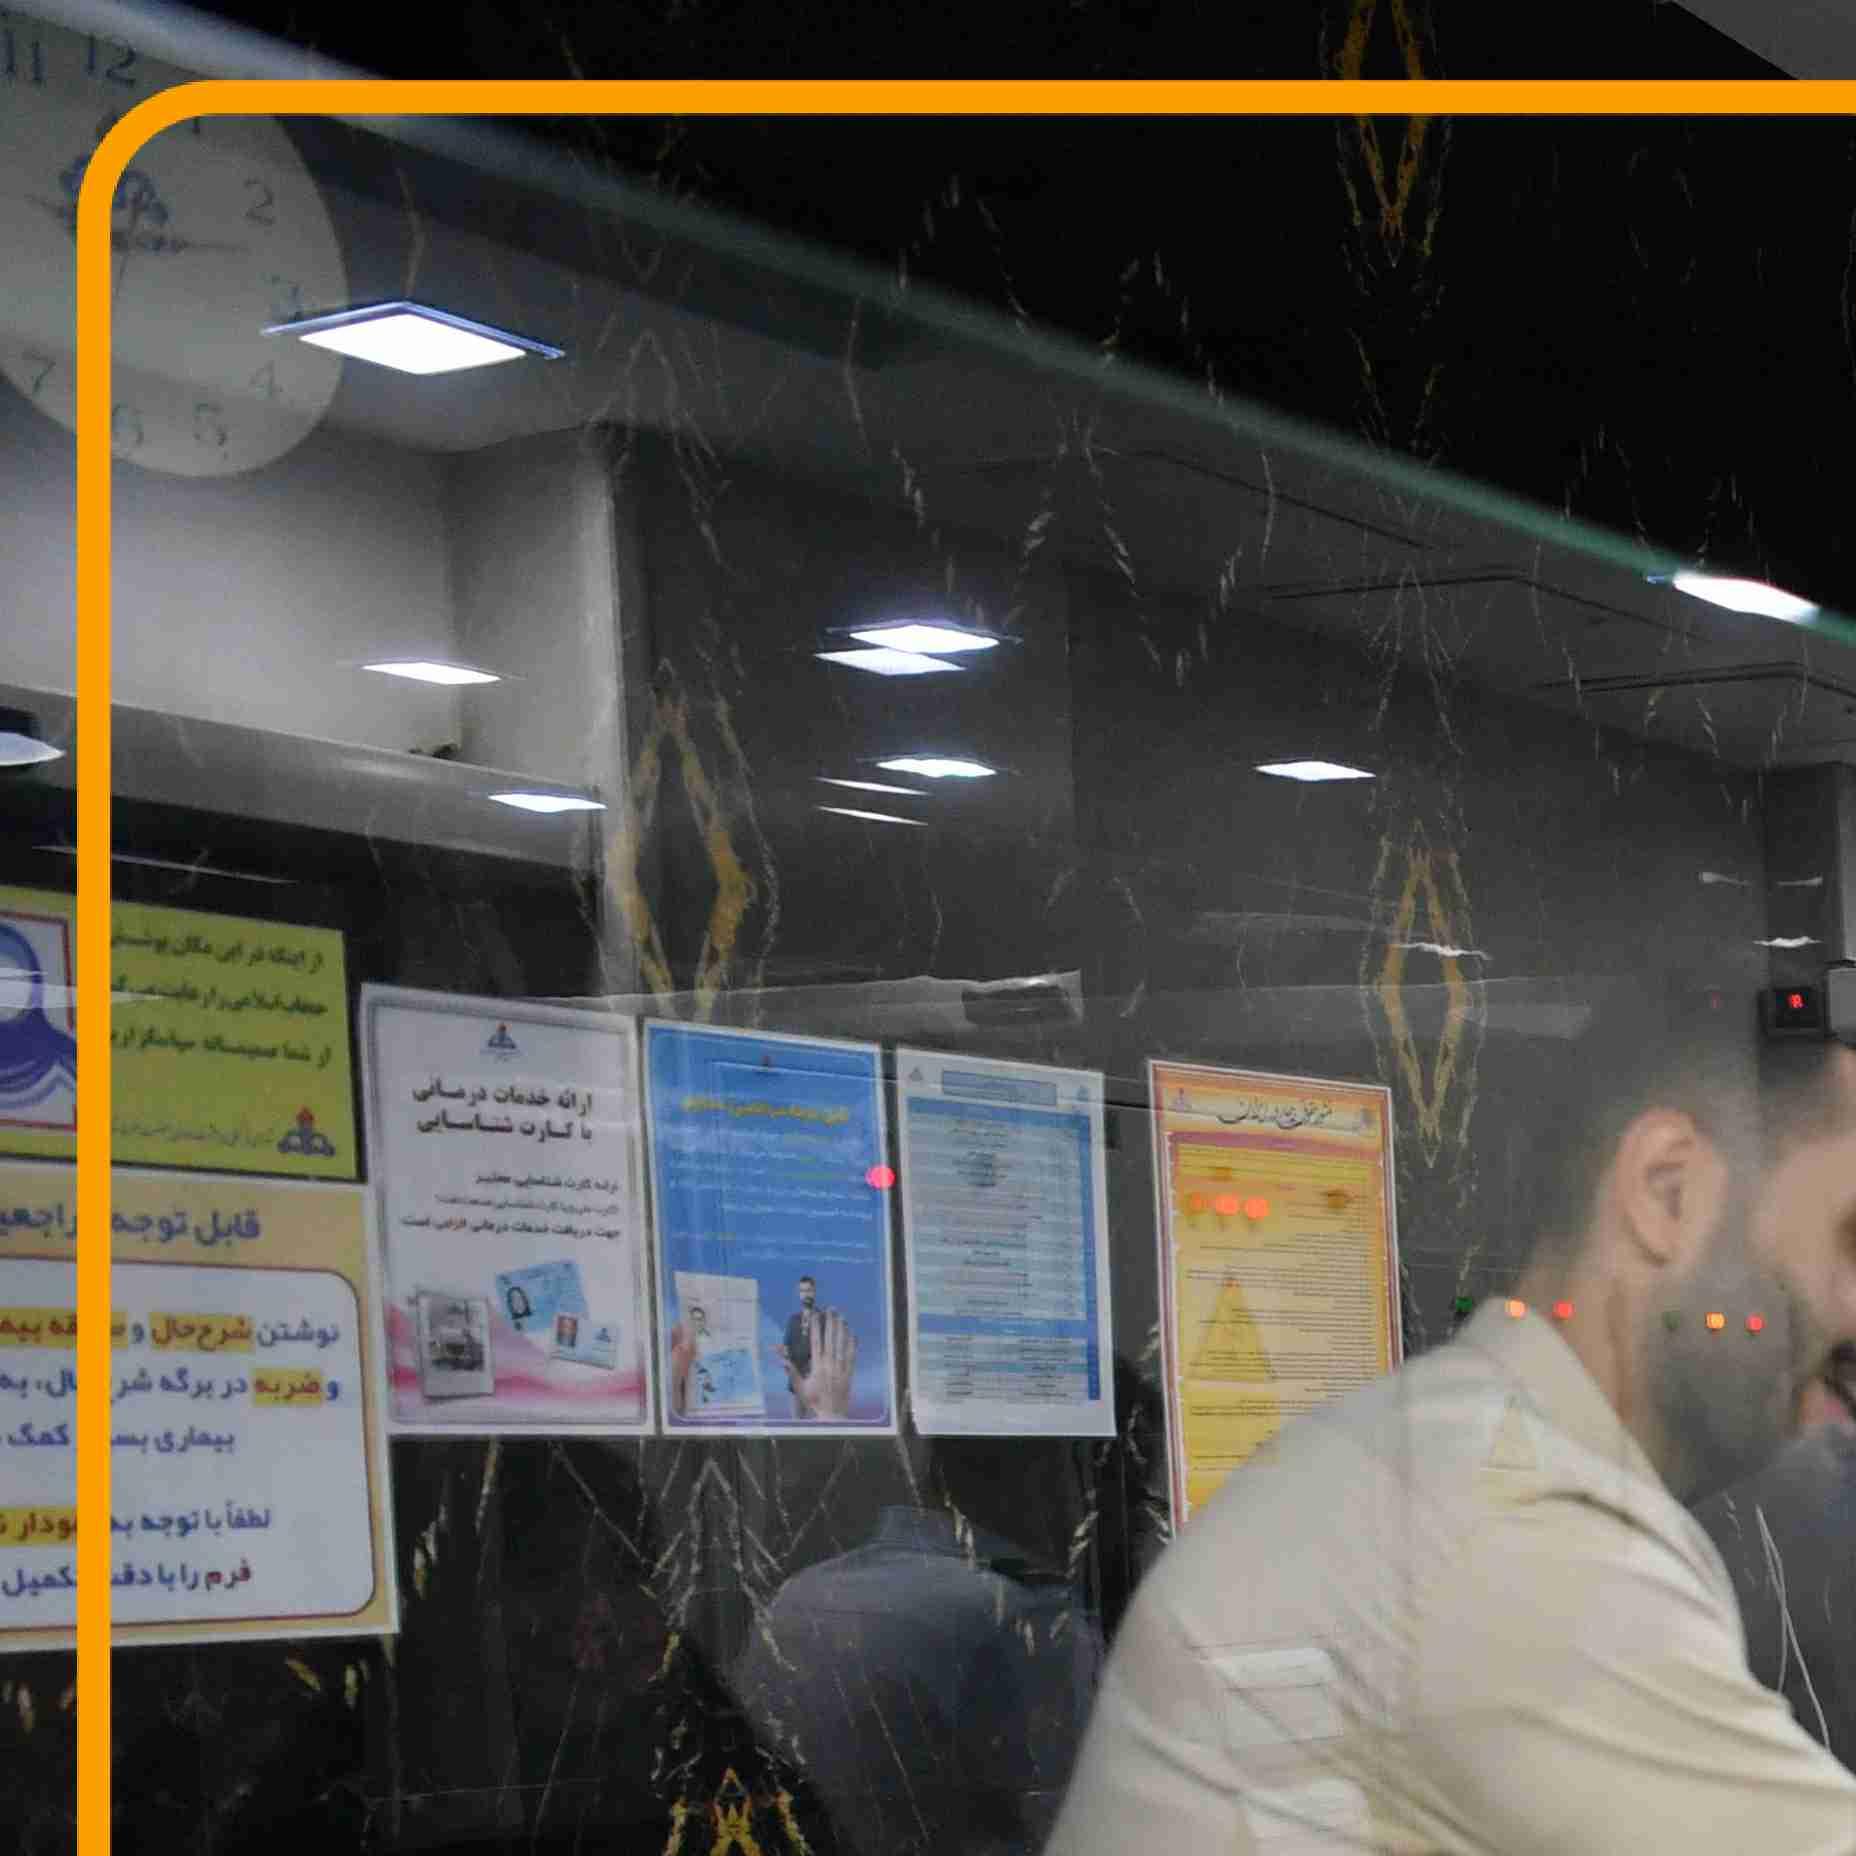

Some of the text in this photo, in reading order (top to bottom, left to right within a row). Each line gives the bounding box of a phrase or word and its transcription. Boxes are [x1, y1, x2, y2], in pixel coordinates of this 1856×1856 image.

[86, 33, 137, 87] 12
[243, 178, 275, 226] 2
[412, 1077, 487, 1107] درمانی
[493, 1084, 550, 1105] خدمات
[417, 1107, 514, 1134] شناسایی
[112, 1206, 188, 1245] توجه
[194, 1206, 260, 1247] قابل
[132, 1321, 145, 1344] و
[256, 1315, 340, 1349] نوشتن
[159, 1365, 216, 1401] برگه
[221, 1379, 249, 1401] در
[254, 1369, 322, 1401] ضربه
[326, 1380, 339, 1400] و
[154, 1424, 235, 1453] بیماری
[140, 1511, 200, 1538] توجه
[204, 1554, 252, 1593] فرم
